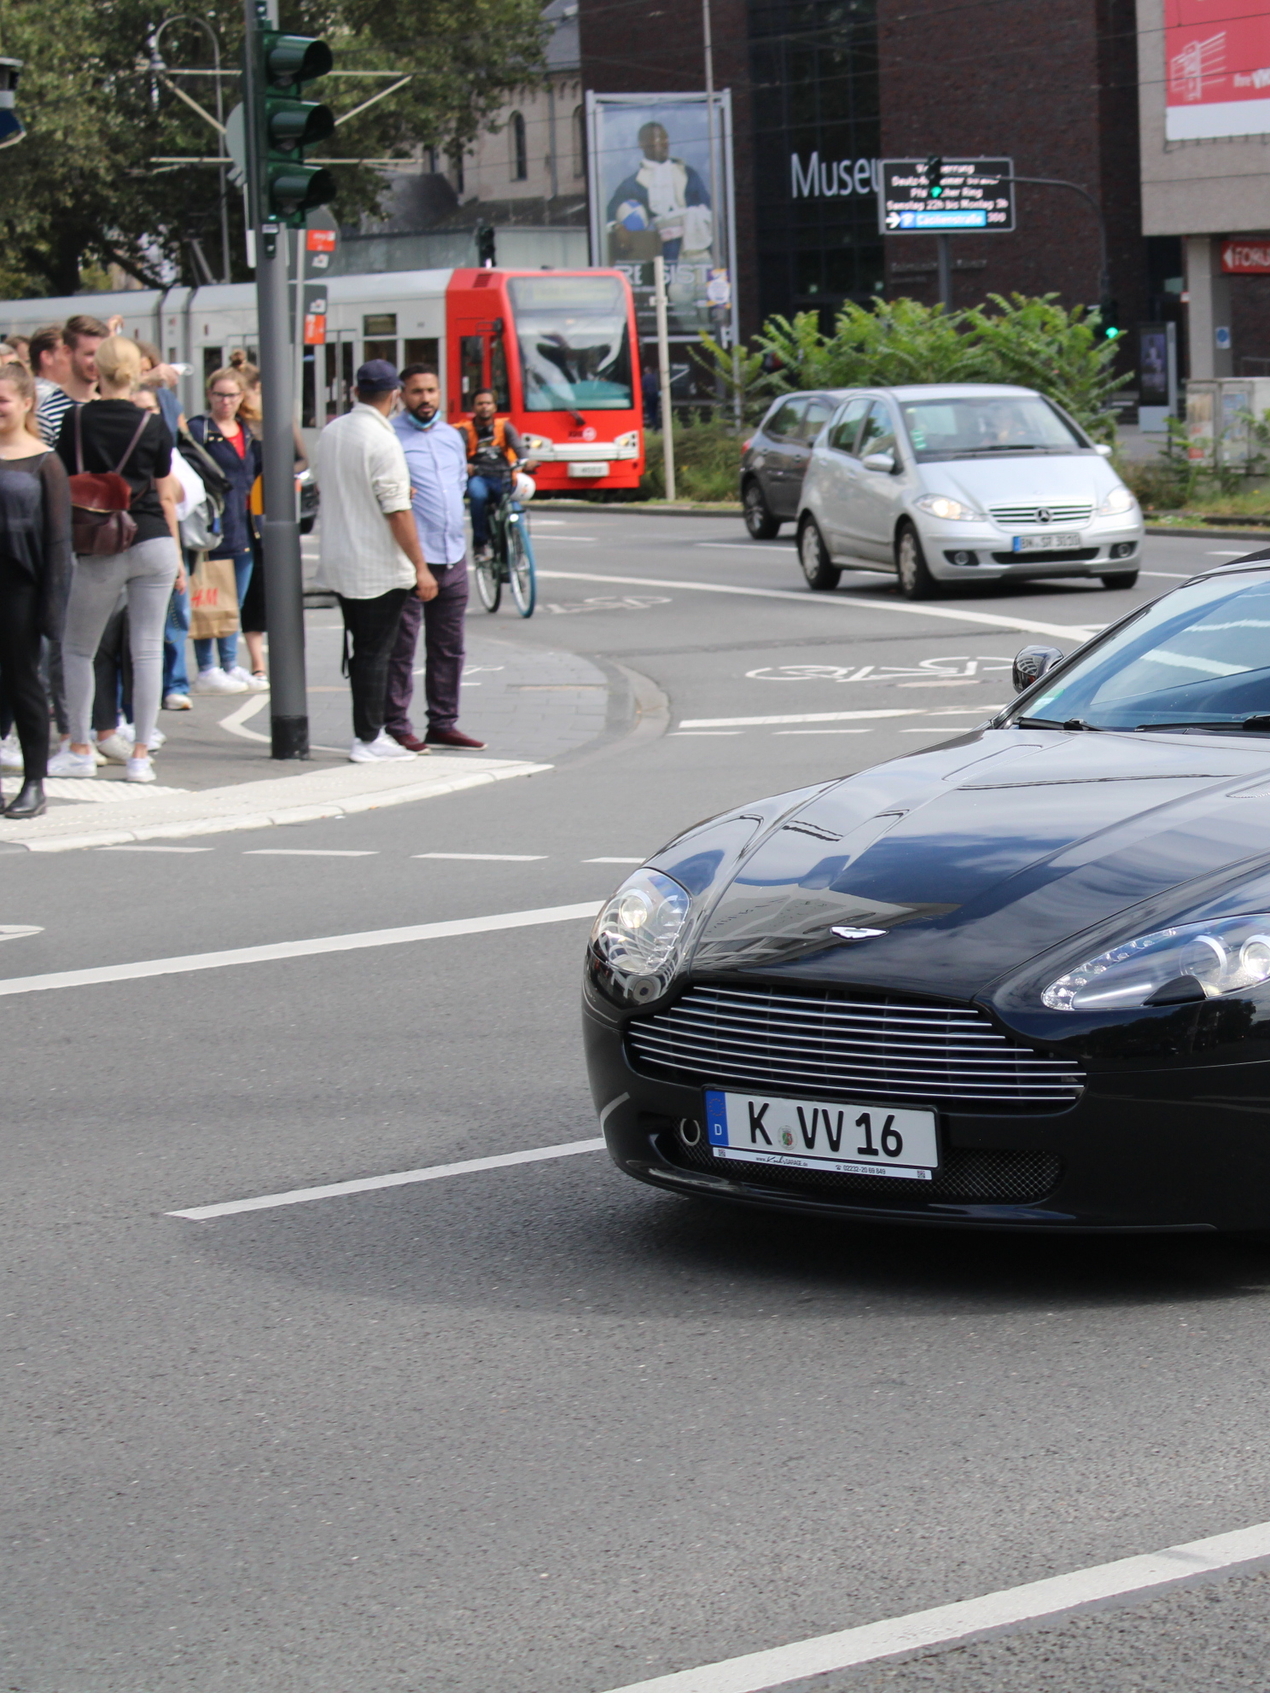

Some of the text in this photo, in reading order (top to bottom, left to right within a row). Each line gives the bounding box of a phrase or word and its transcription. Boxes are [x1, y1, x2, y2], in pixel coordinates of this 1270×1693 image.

[714, 1123, 722, 1136] D
[748, 1100, 904, 1158] K VV 16
